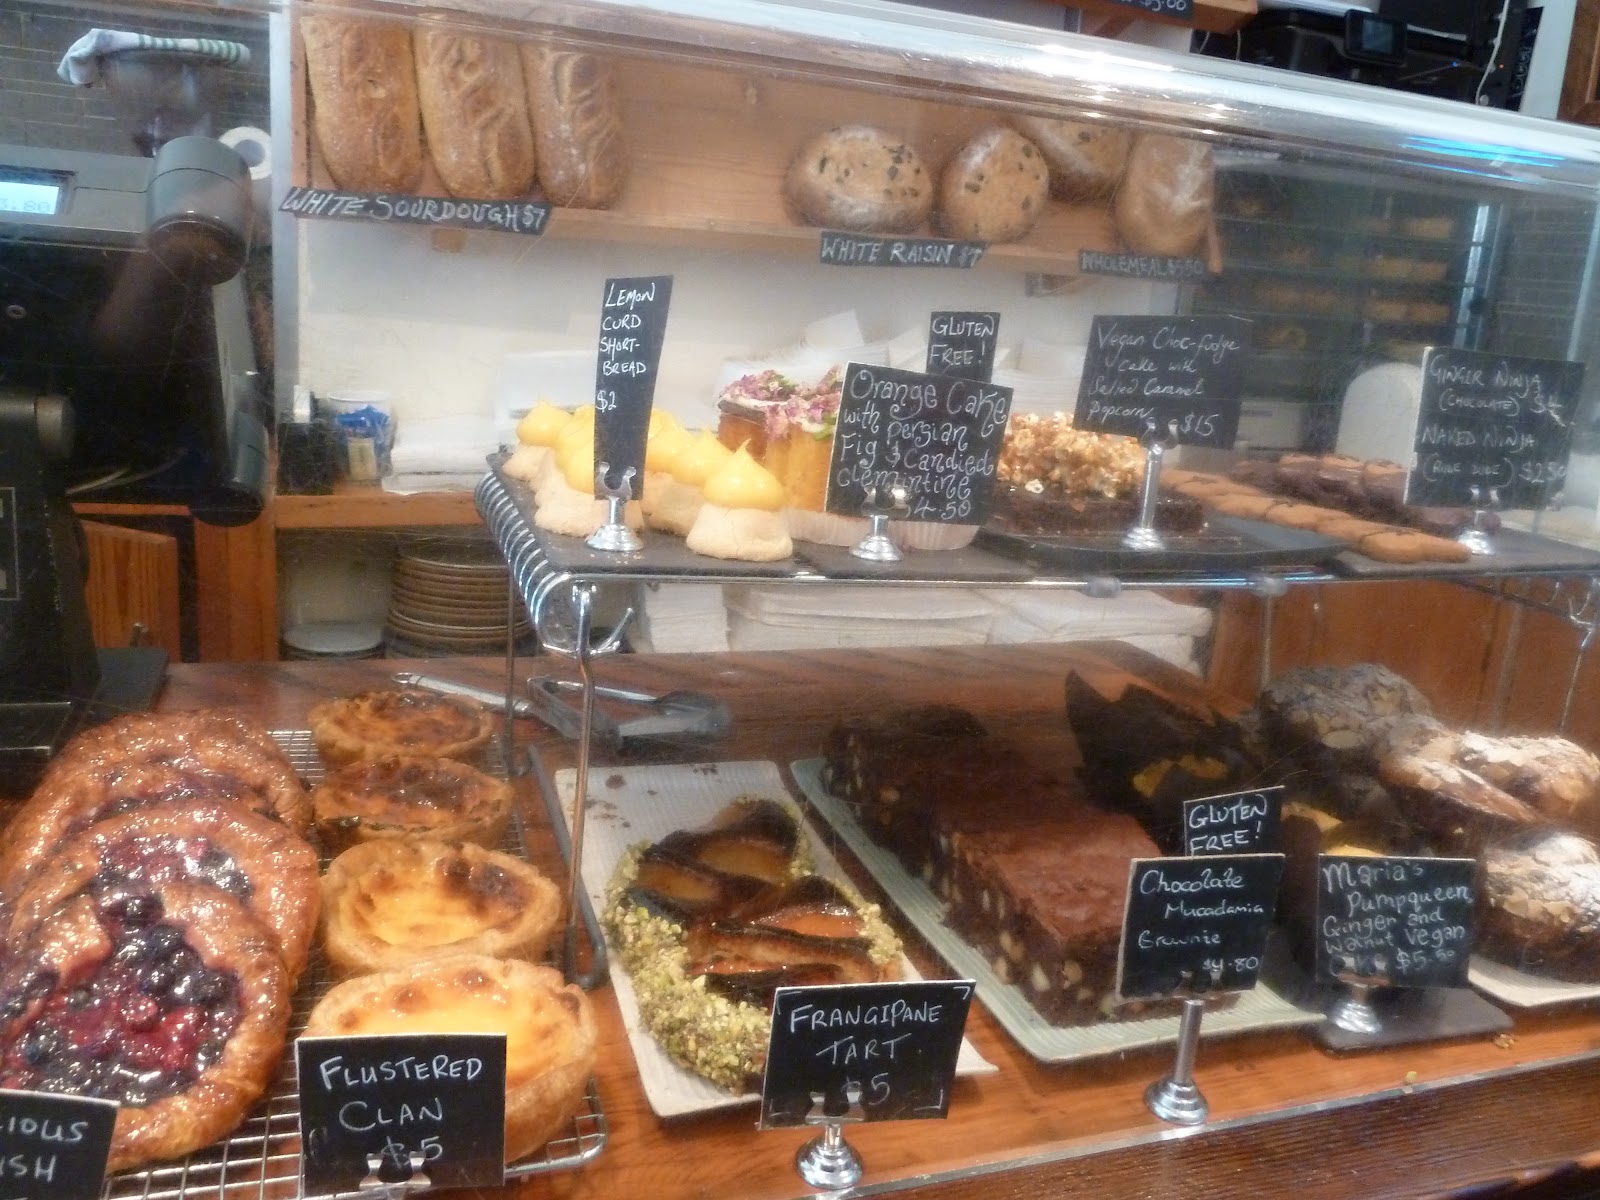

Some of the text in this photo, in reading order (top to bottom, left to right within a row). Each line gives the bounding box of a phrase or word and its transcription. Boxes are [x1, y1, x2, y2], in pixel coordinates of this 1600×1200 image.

[283, 187, 545, 232] WHITE SOURDOUGH $7
[821, 237, 884, 263] WHITE
[890, 242, 955, 265] RAISIN
[605, 282, 656, 311] LEMON
[602, 314, 642, 331] CURD
[932, 314, 995, 338] GLUTEN
[599, 336, 641, 361] SHORT-
[1098, 322, 1145, 367] Vegan
[602, 360, 647, 378] BREAD
[1168, 359, 1197, 373] with
[1429, 354, 1542, 398] GINGER NINJA
[595, 390, 617, 413] $2
[1088, 375, 1205, 397] Salted Caramel
[844, 400, 881, 434] with
[850, 369, 1007, 438] Orange Cake
[1180, 411, 1220, 437] $15
[1421, 423, 1536, 454] NAKED NINJA
[841, 432, 877, 470] Fig
[903, 447, 995, 476] Candied
[1188, 793, 1268, 829] GLUTEN
[1189, 820, 1262, 857] FREE!
[1139, 867, 1246, 895] Chocolate
[1322, 860, 1424, 894] Maria's
[1164, 898, 1264, 920] Macadamia
[1322, 905, 1445, 940] Ginger and
[1202, 956, 1260, 973] $4.80
[789, 998, 943, 1034] FRANGIPANE
[815, 1032, 913, 1066] TART
[319, 1053, 483, 1092] FLUSTERED
[338, 1096, 444, 1132] CLAN
[380, 1135, 444, 1168] $5
